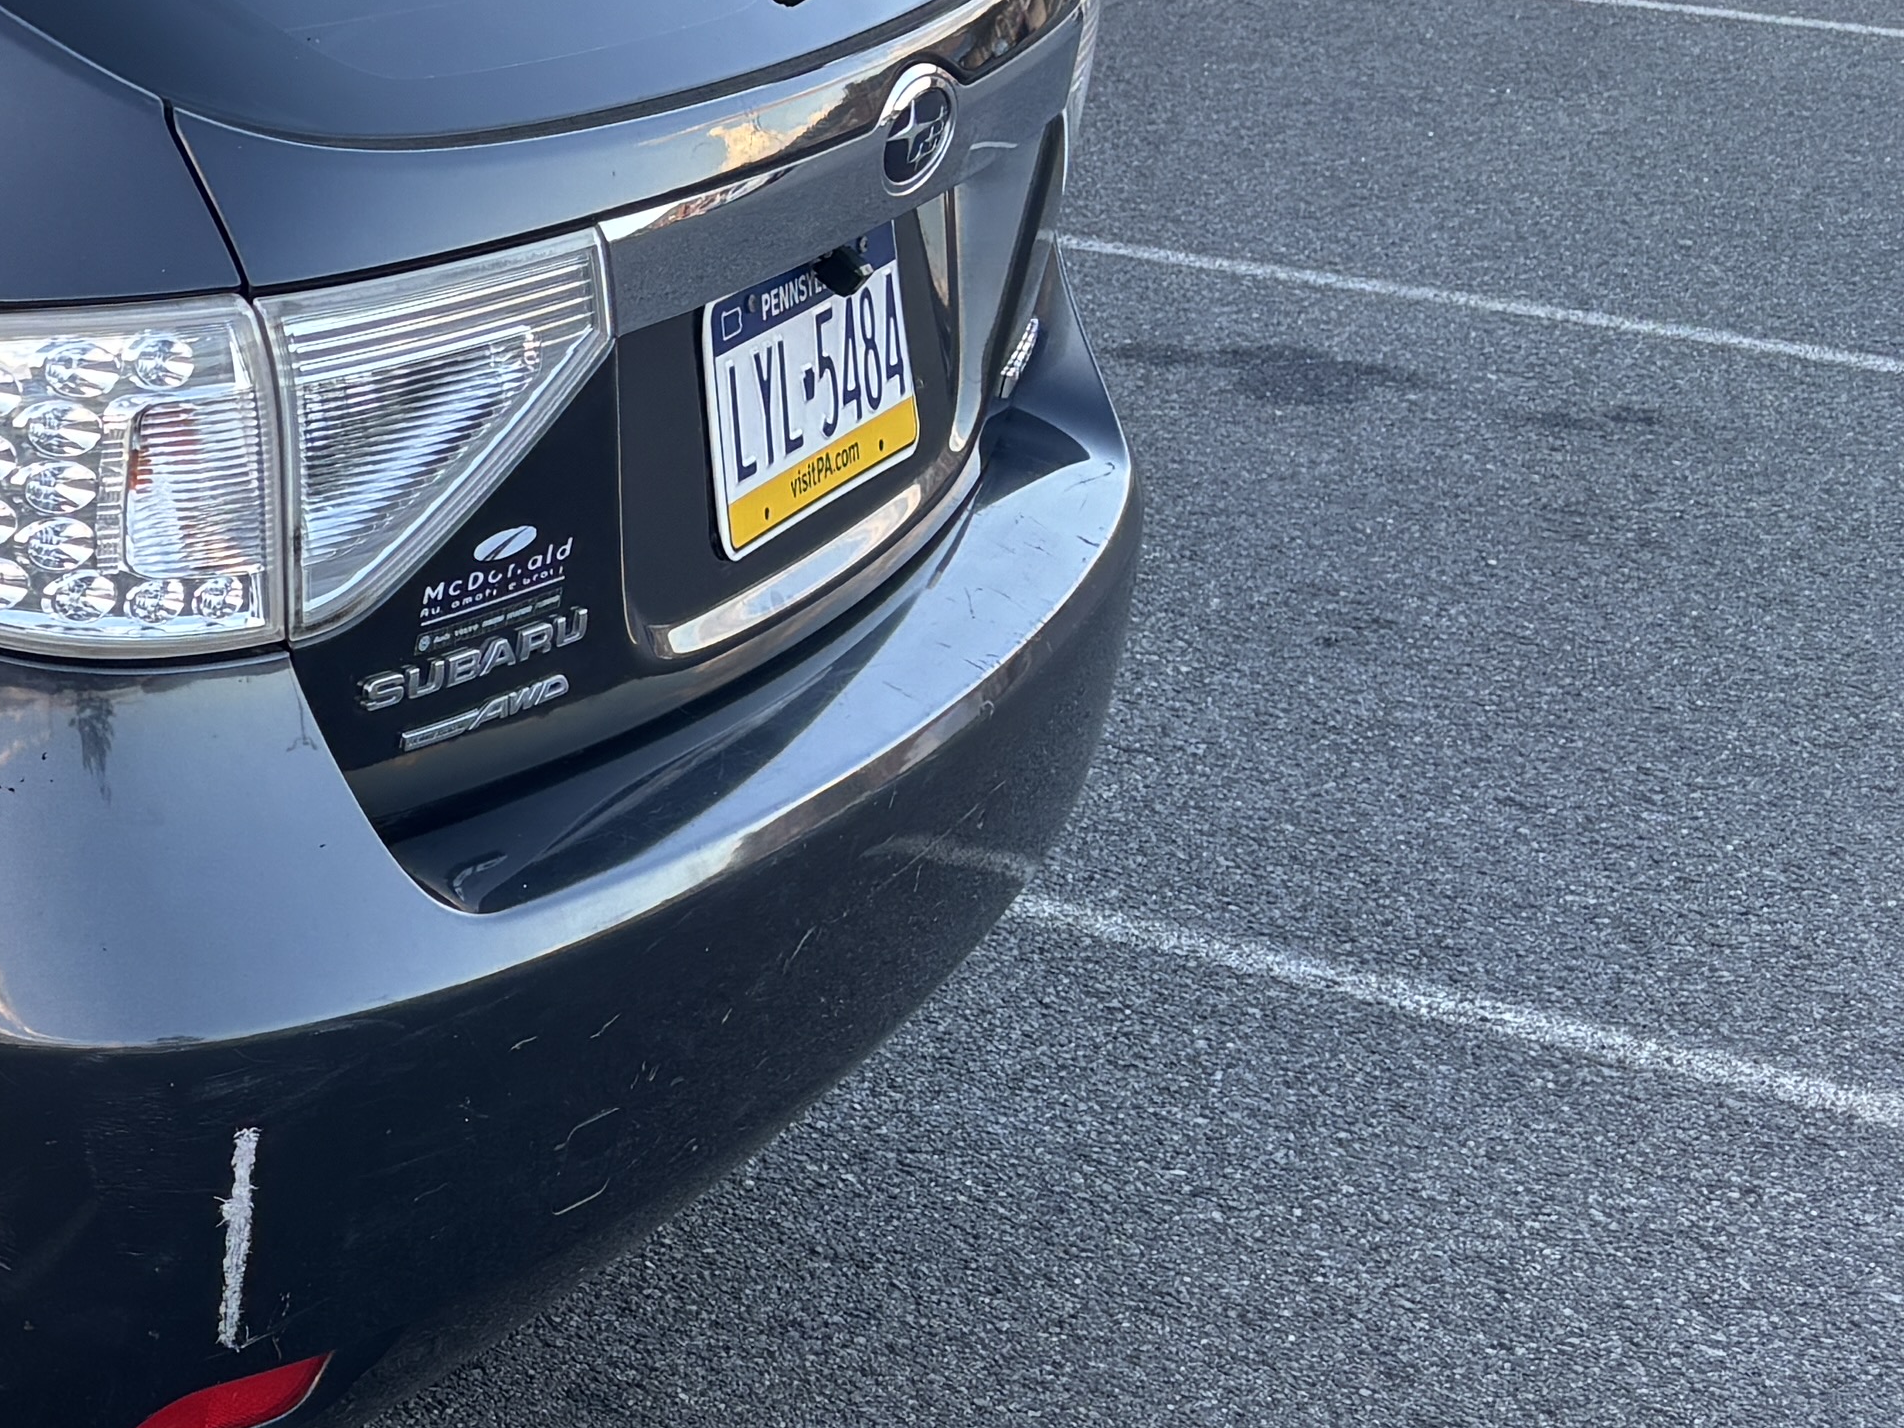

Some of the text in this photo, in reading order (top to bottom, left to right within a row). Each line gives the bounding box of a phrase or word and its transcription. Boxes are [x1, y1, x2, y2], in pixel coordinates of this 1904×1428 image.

[790, 441, 861, 498] visitPA.com
[357, 606, 588, 712] SUBARU
[467, 673, 570, 731] AWD
